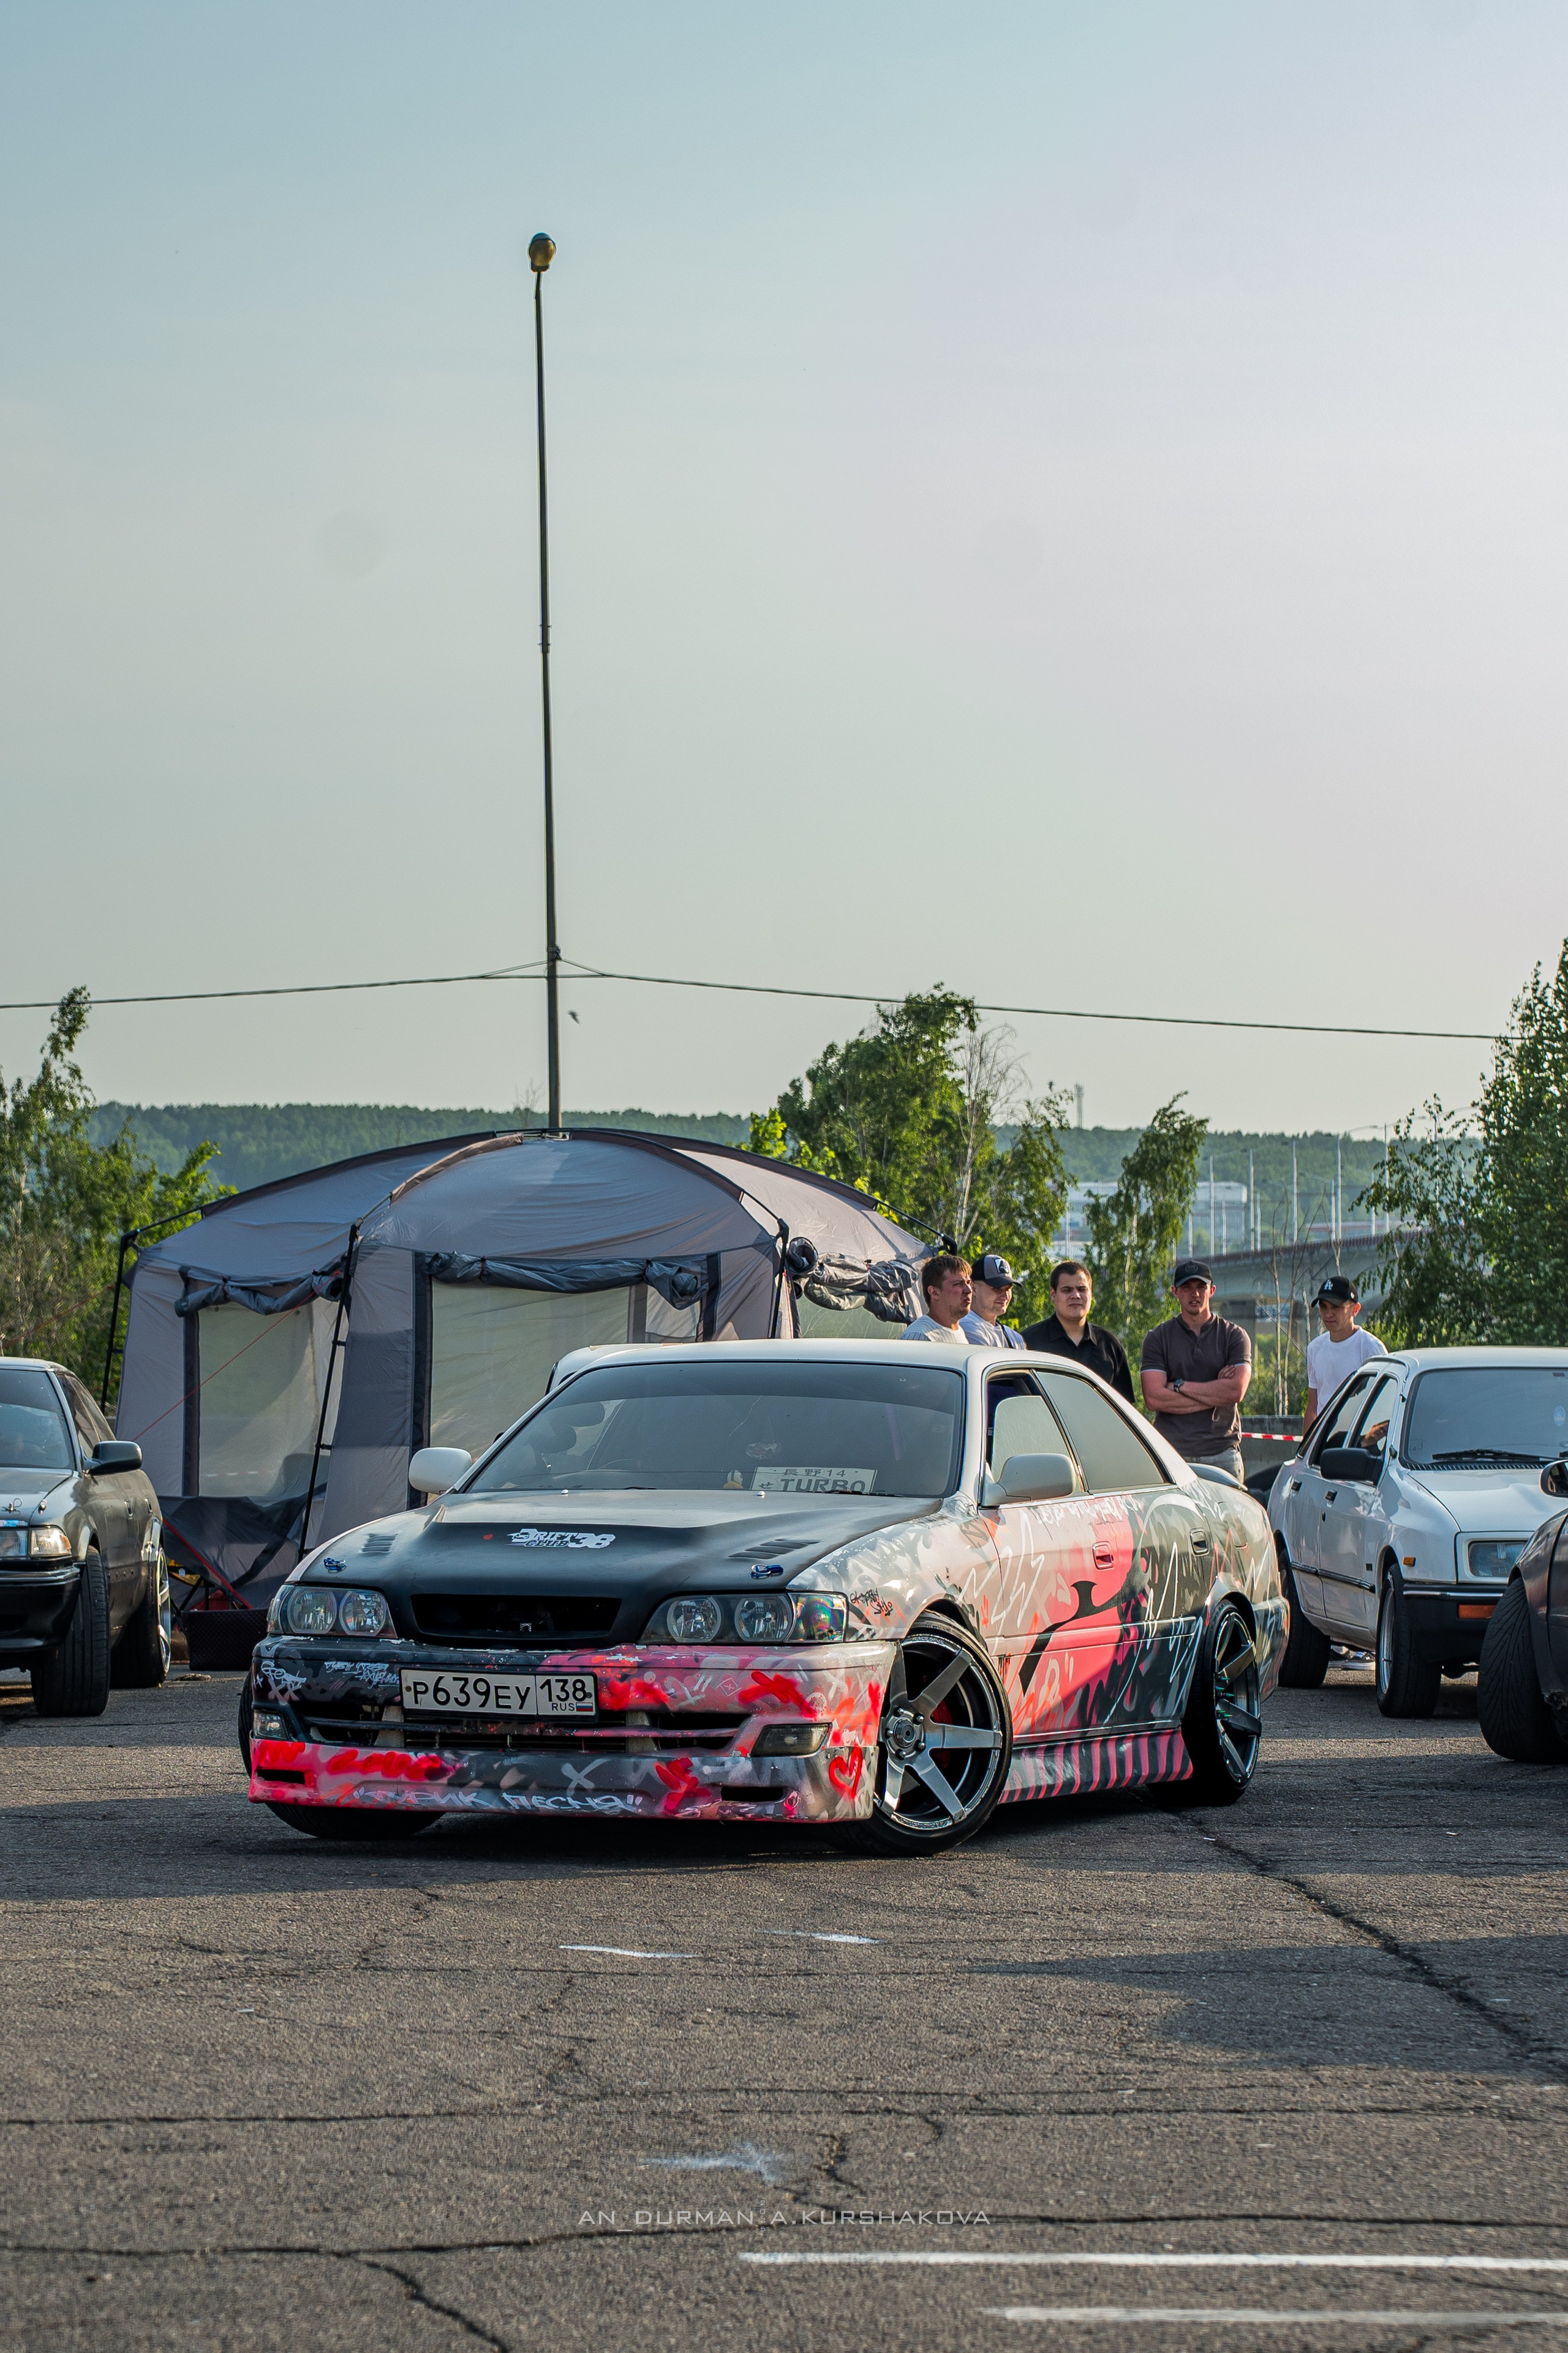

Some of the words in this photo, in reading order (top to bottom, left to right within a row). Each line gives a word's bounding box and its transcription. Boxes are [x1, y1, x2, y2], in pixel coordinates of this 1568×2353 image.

[780, 1478, 866, 1493] TURBO
[568, 1533, 616, 1549] 38
[412, 1675, 532, 1710] Р639ЕУ
[538, 1678, 587, 1702] 138
[551, 1702, 575, 1712] RUS
